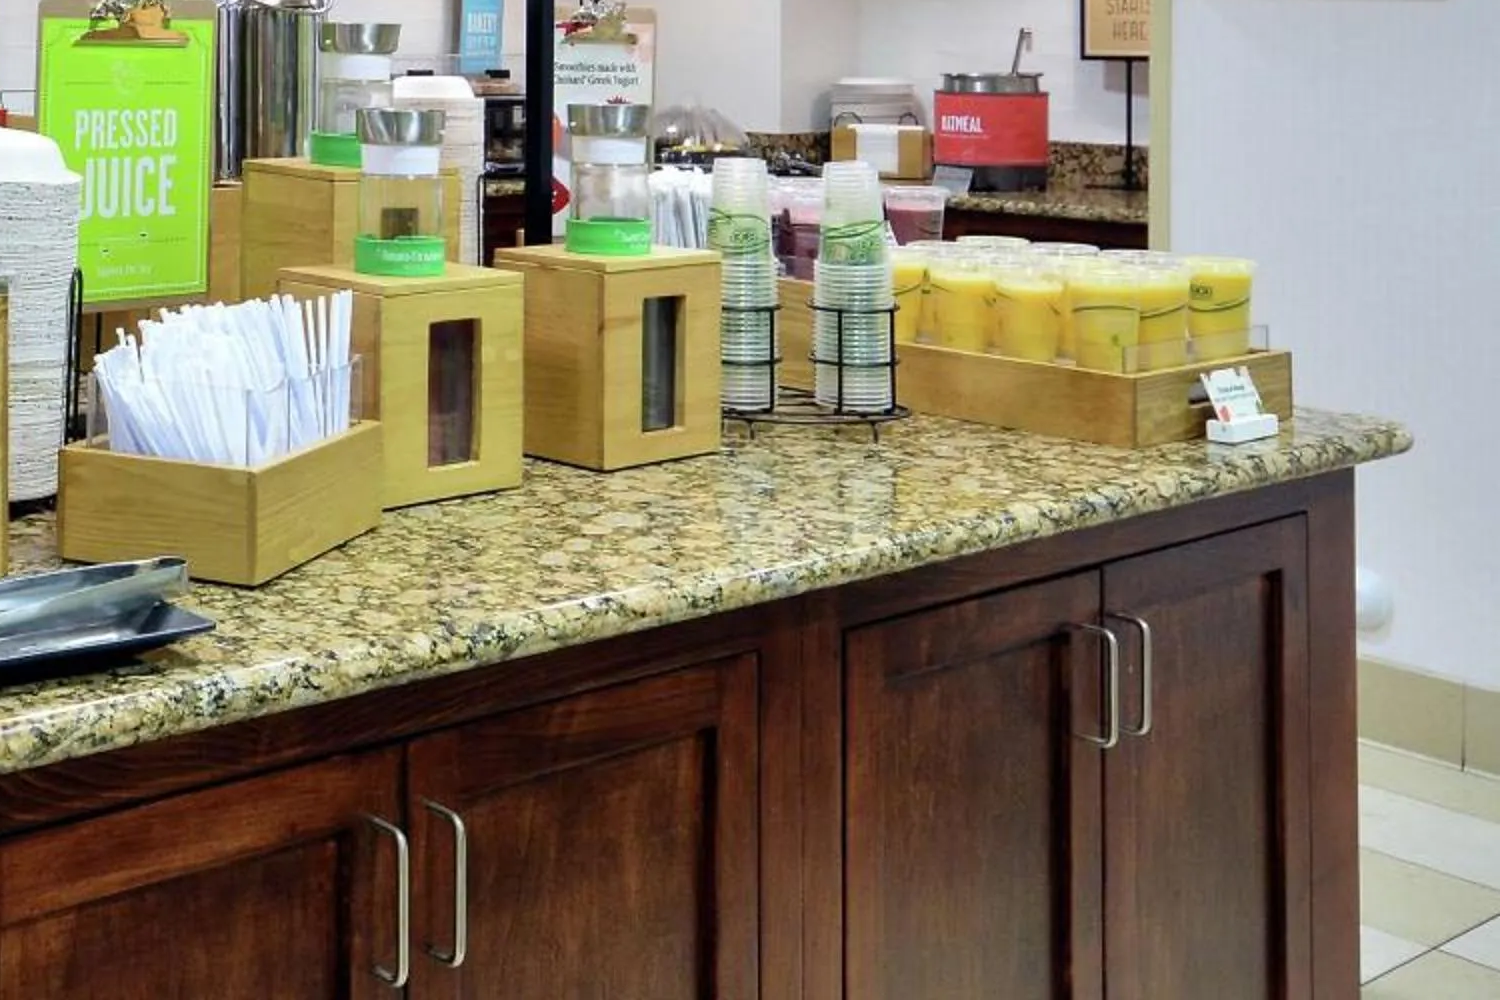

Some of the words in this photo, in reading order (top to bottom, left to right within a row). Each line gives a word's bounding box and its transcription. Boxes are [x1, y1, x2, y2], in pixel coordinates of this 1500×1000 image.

[1112, 20, 1147, 41] HERE
[74, 108, 179, 151] PRESSED
[941, 114, 984, 133] OATMEAL
[74, 152, 178, 220] JUICE
